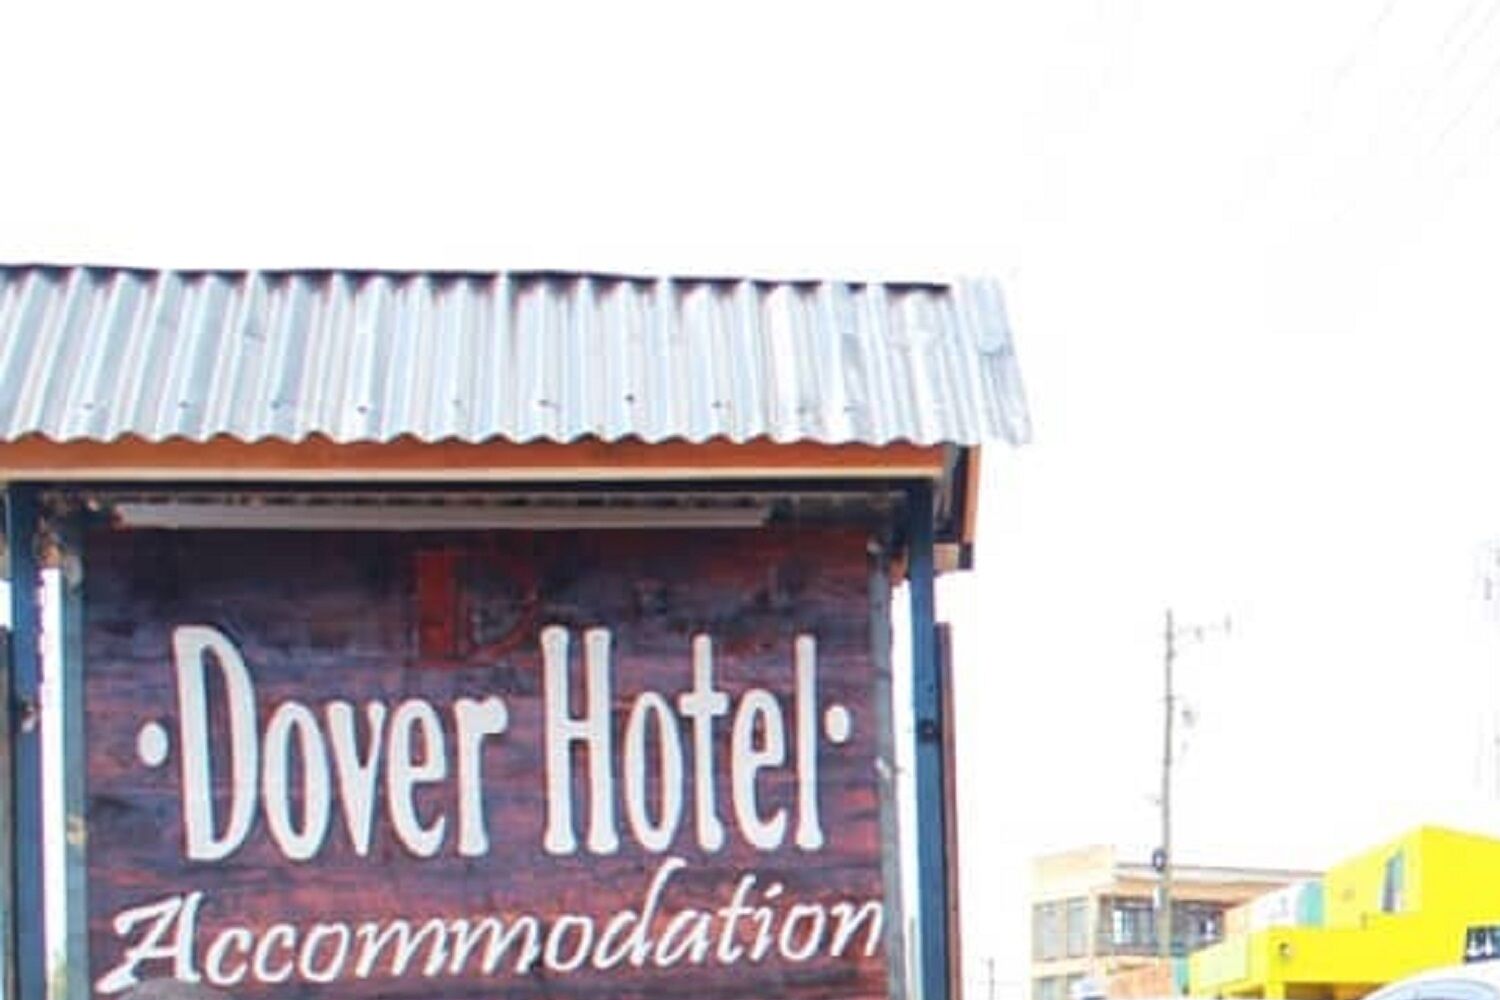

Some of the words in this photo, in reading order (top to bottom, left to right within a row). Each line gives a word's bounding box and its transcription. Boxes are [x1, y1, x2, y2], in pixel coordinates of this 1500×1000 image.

[172, 624, 508, 862] Dover
[541, 624, 826, 855] Hotel
[95, 859, 884, 994] Accommodation
